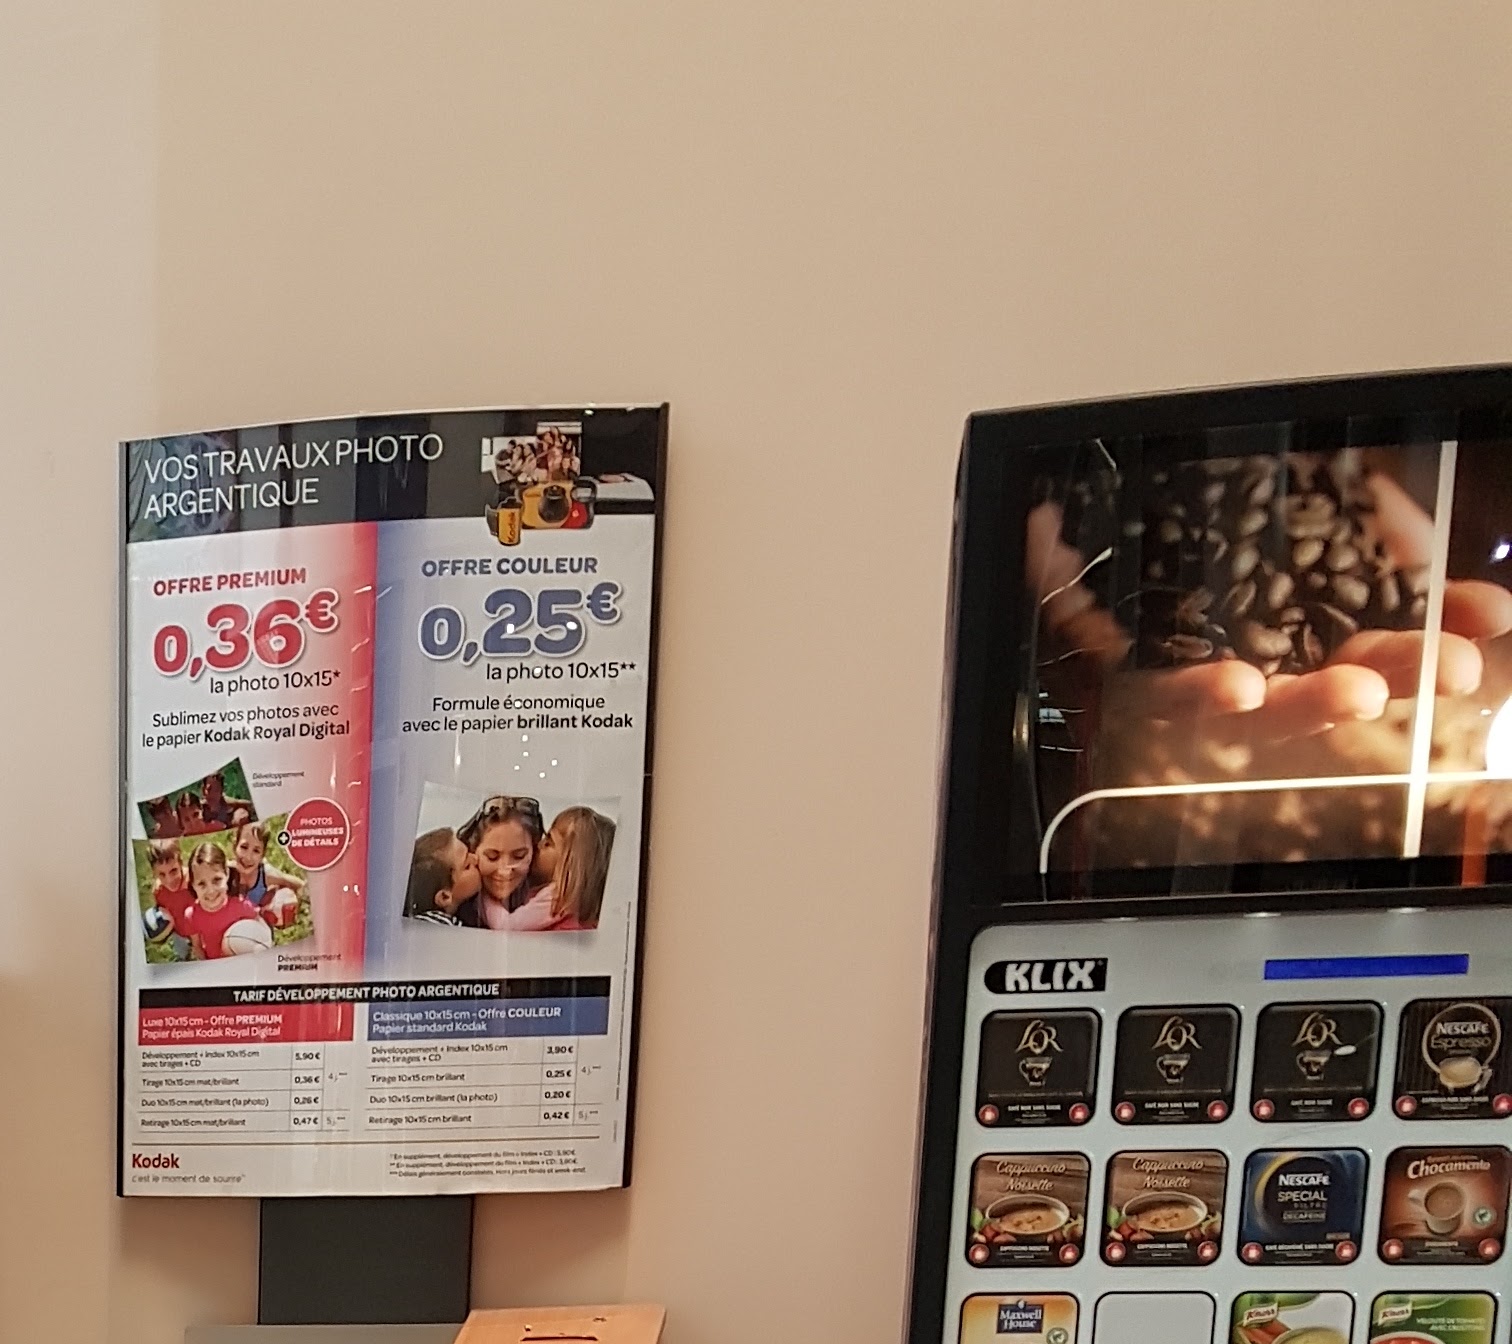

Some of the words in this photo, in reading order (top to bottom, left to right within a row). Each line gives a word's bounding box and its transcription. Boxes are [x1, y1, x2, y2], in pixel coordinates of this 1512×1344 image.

[144, 454, 198, 484] VOS
[204, 440, 330, 477] TRAVAUX
[336, 433, 444, 466] PHOTO
[144, 478, 320, 520] ARGENTIQUE
[421, 558, 491, 577] OFFRE
[497, 557, 598, 574] COULEUR
[153, 576, 212, 596] OFFRE
[217, 568, 306, 590] PREMIUM
[419, 581, 622, 665] 0,25€
[153, 589, 338, 680] 0,36€
[486, 664, 502, 680] la
[506, 663, 564, 684] photo
[210, 677, 224, 694] la
[228, 676, 280, 696] photo
[433, 696, 500, 712] Formule
[503, 694, 605, 715] économique
[153, 711, 216, 727] Sublimez
[219, 710, 243, 723] vos
[247, 705, 299, 723] photos
[303, 704, 339, 717] avec
[402, 719, 441, 733] avec
[444, 716, 457, 730] le
[461, 716, 513, 733] papier
[517, 715, 577, 729] brillant
[581, 714, 633, 729] Kodak
[142, 733, 154, 748] le
[157, 731, 201, 750] papier
[204, 727, 250, 743] Kodak
[253, 723, 295, 742] Royal
[300, 720, 350, 740] Digital
[300, 817, 333, 826] PHOTOS
[292, 827, 344, 836] LUMINEUSES
[292, 838, 303, 846] DE
[303, 837, 339, 846] DÉTAILS
[1004, 959, 1096, 992] KLIX
[233, 989, 267, 1004] TARIF
[268, 984, 371, 1003] DÉVELOPPEMENT
[372, 984, 417, 1000] PHOTO
[417, 982, 500, 999] ARGENTIQUE
[143, 1018, 163, 1027] Luxe
[165, 1017, 188, 1027] 10x15
[189, 1018, 203, 1026] cm
[210, 1016, 235, 1025] Offre
[236, 1014, 283, 1024] PREMIUM
[373, 1011, 422, 1022] Classique
[425, 1010, 452, 1020] 10x15
[453, 1011, 470, 1019] cm
[478, 1009, 506, 1019] Offre
[508, 1007, 561, 1018] COULEUR
[142, 1029, 169, 1040] Papier
[195, 1027, 224, 1038] Kodak
[224, 1026, 250, 1038] Royal
[251, 1025, 281, 1039] Digital
[373, 1023, 404, 1035] Papier
[407, 1022, 454, 1033] standard
[455, 1021, 487, 1031] Kodak
[1430, 1035, 1491, 1050] Espresso
[132, 1153, 179, 1168] Kodak
[996, 1160, 1066, 1177] Cappuccino
[1132, 1158, 1204, 1173] Cappuccino
[1407, 1159, 1491, 1179] Chocamento
[1005, 1178, 1054, 1191] Noisette
[1143, 1176, 1191, 1189] Noisette
[1000, 1309, 1041, 1320] Maxwell
[1004, 1320, 1037, 1329] House
